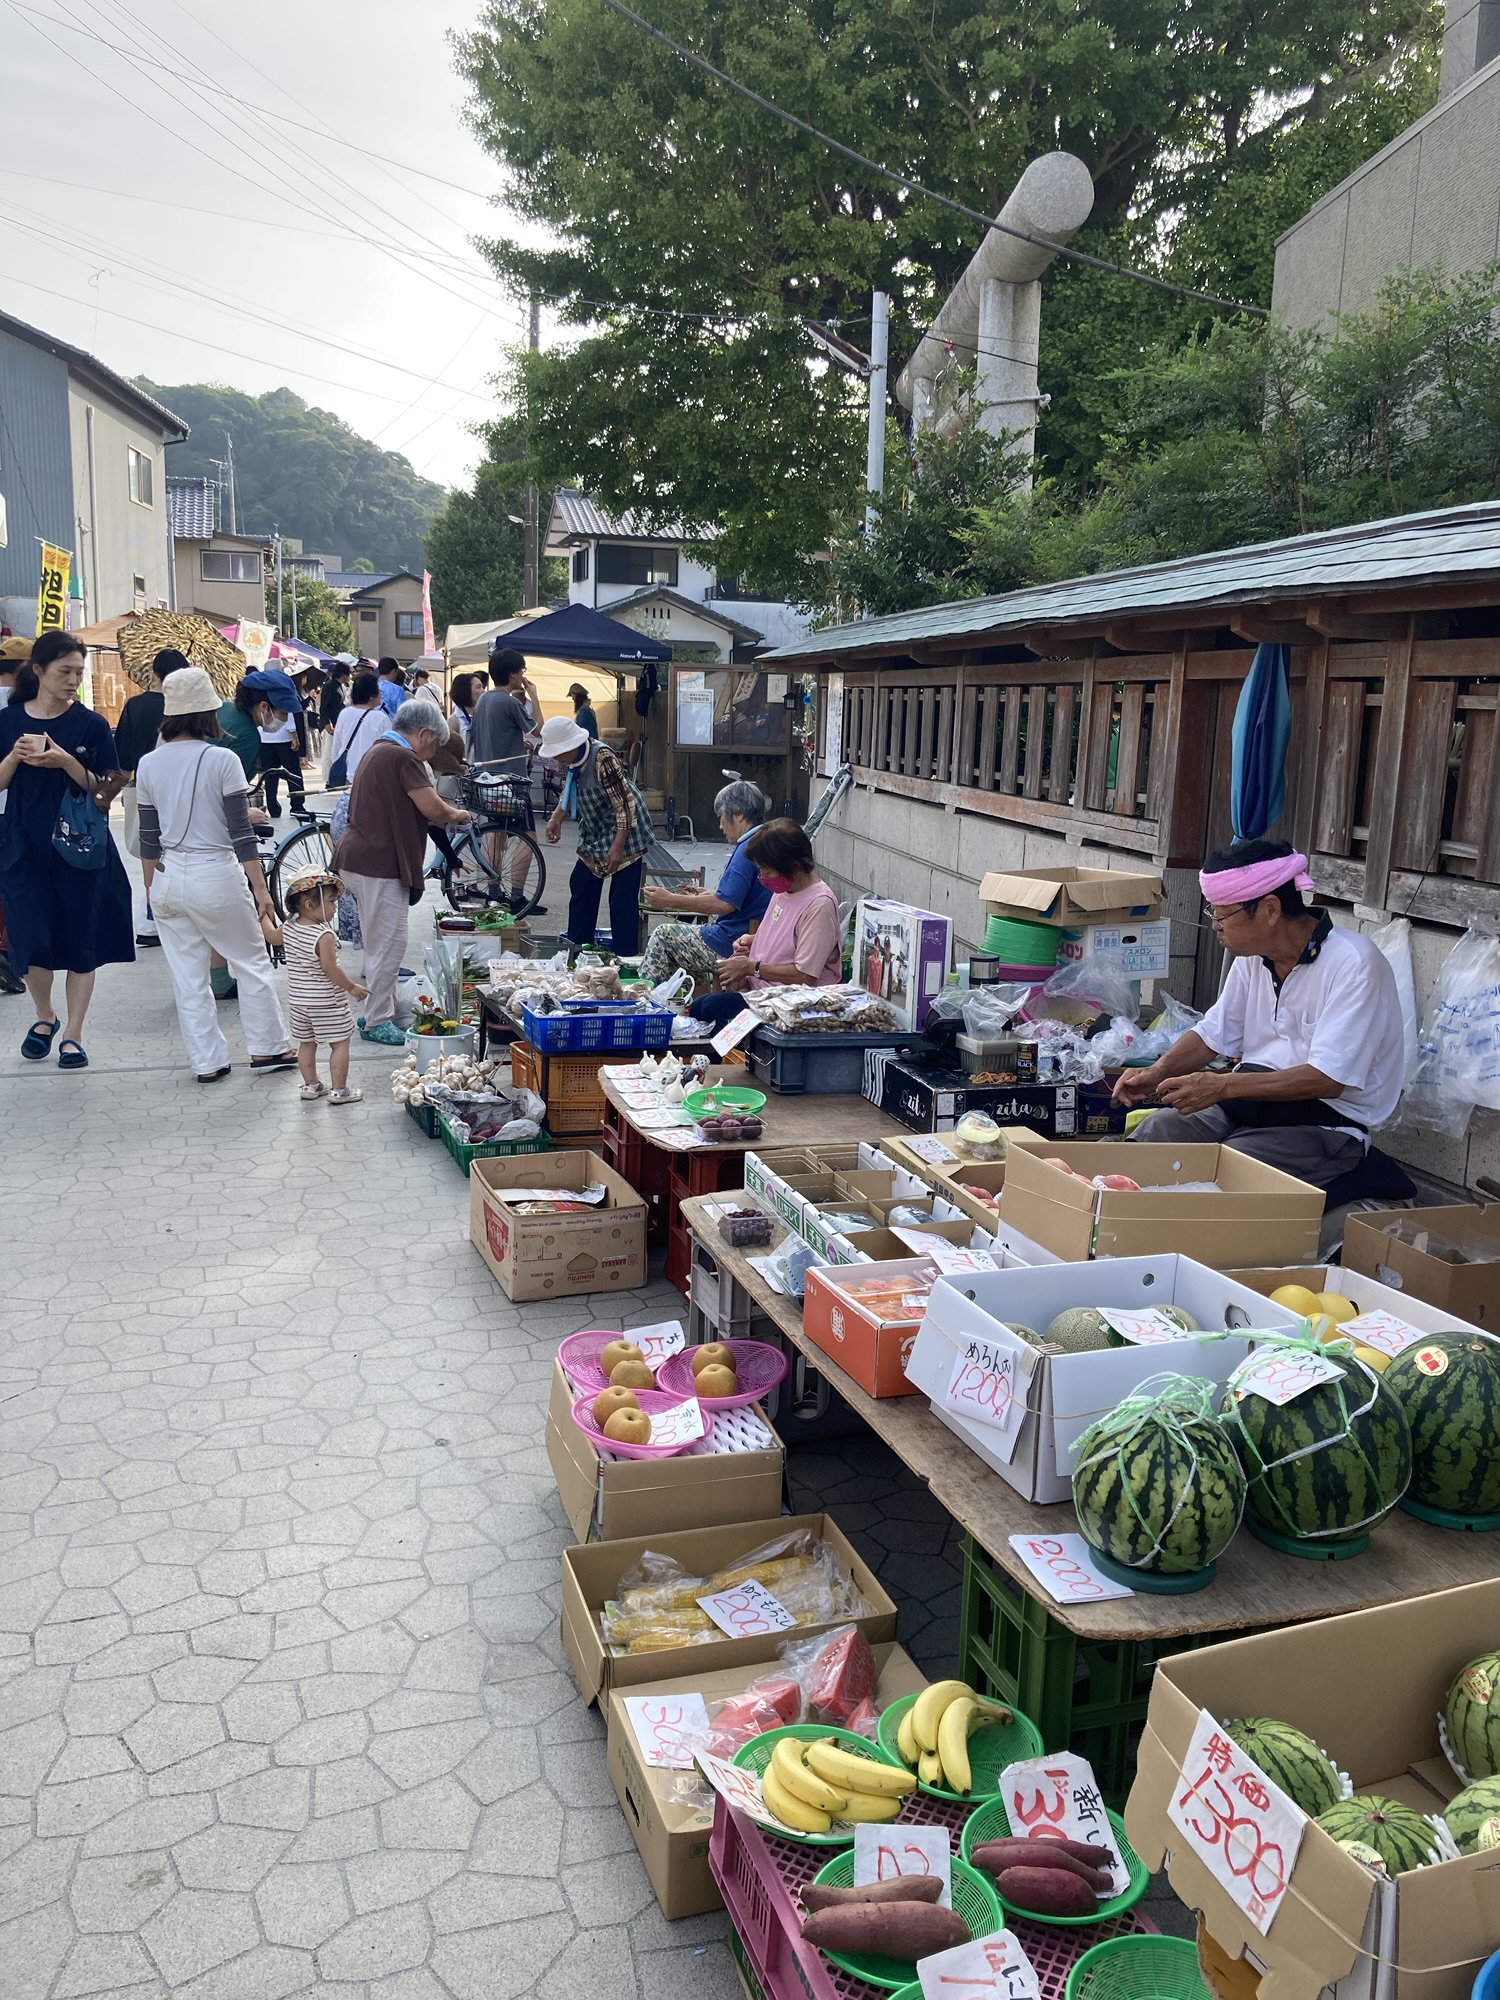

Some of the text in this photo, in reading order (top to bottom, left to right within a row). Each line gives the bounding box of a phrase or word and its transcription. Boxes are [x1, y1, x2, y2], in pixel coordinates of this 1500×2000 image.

[601, 1258, 627, 1268] BANANAS
[567, 1272, 595, 1282] SUMIFRU
[1202, 1733, 1271, 1813] 特価
